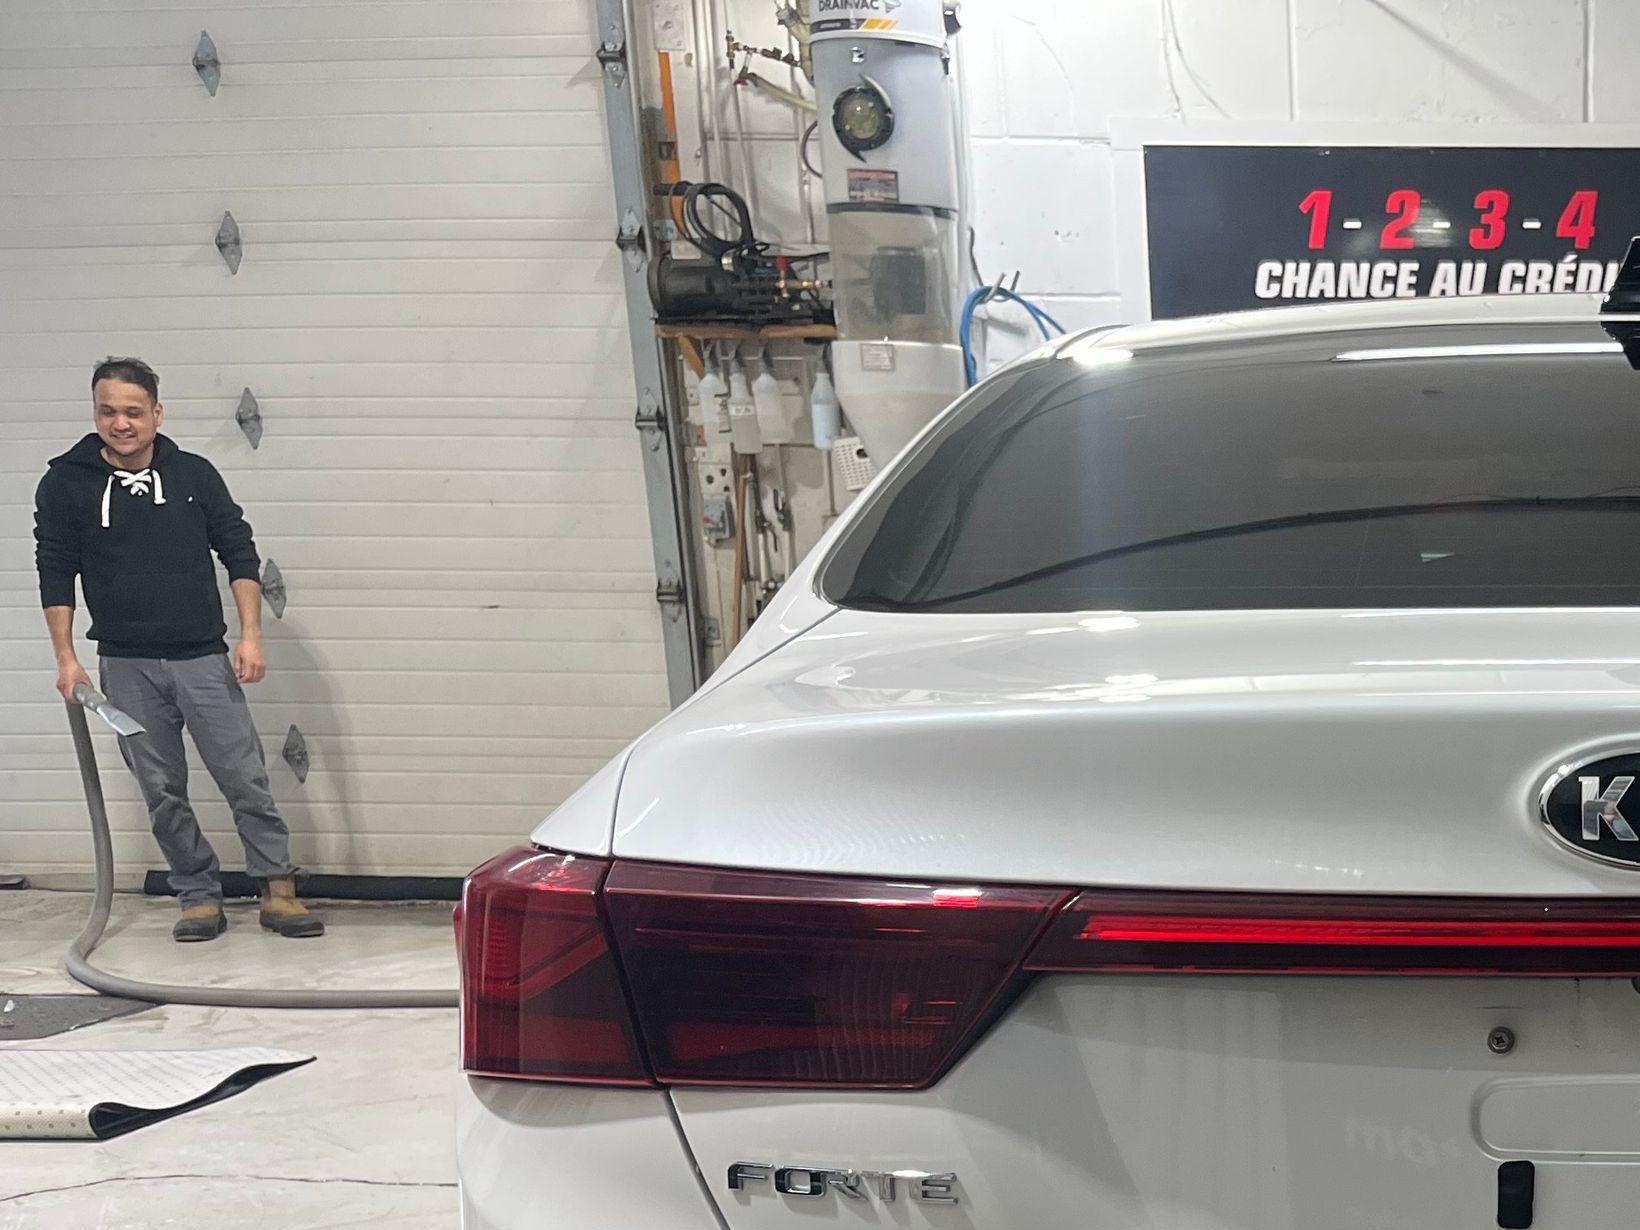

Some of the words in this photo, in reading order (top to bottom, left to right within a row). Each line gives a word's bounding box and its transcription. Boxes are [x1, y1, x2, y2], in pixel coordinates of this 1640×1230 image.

[1254, 260, 1419, 299] CHANCE
[1428, 260, 1488, 297] AU
[1497, 251, 1626, 294] CRÉDI
[728, 1161, 959, 1205] FORTE
